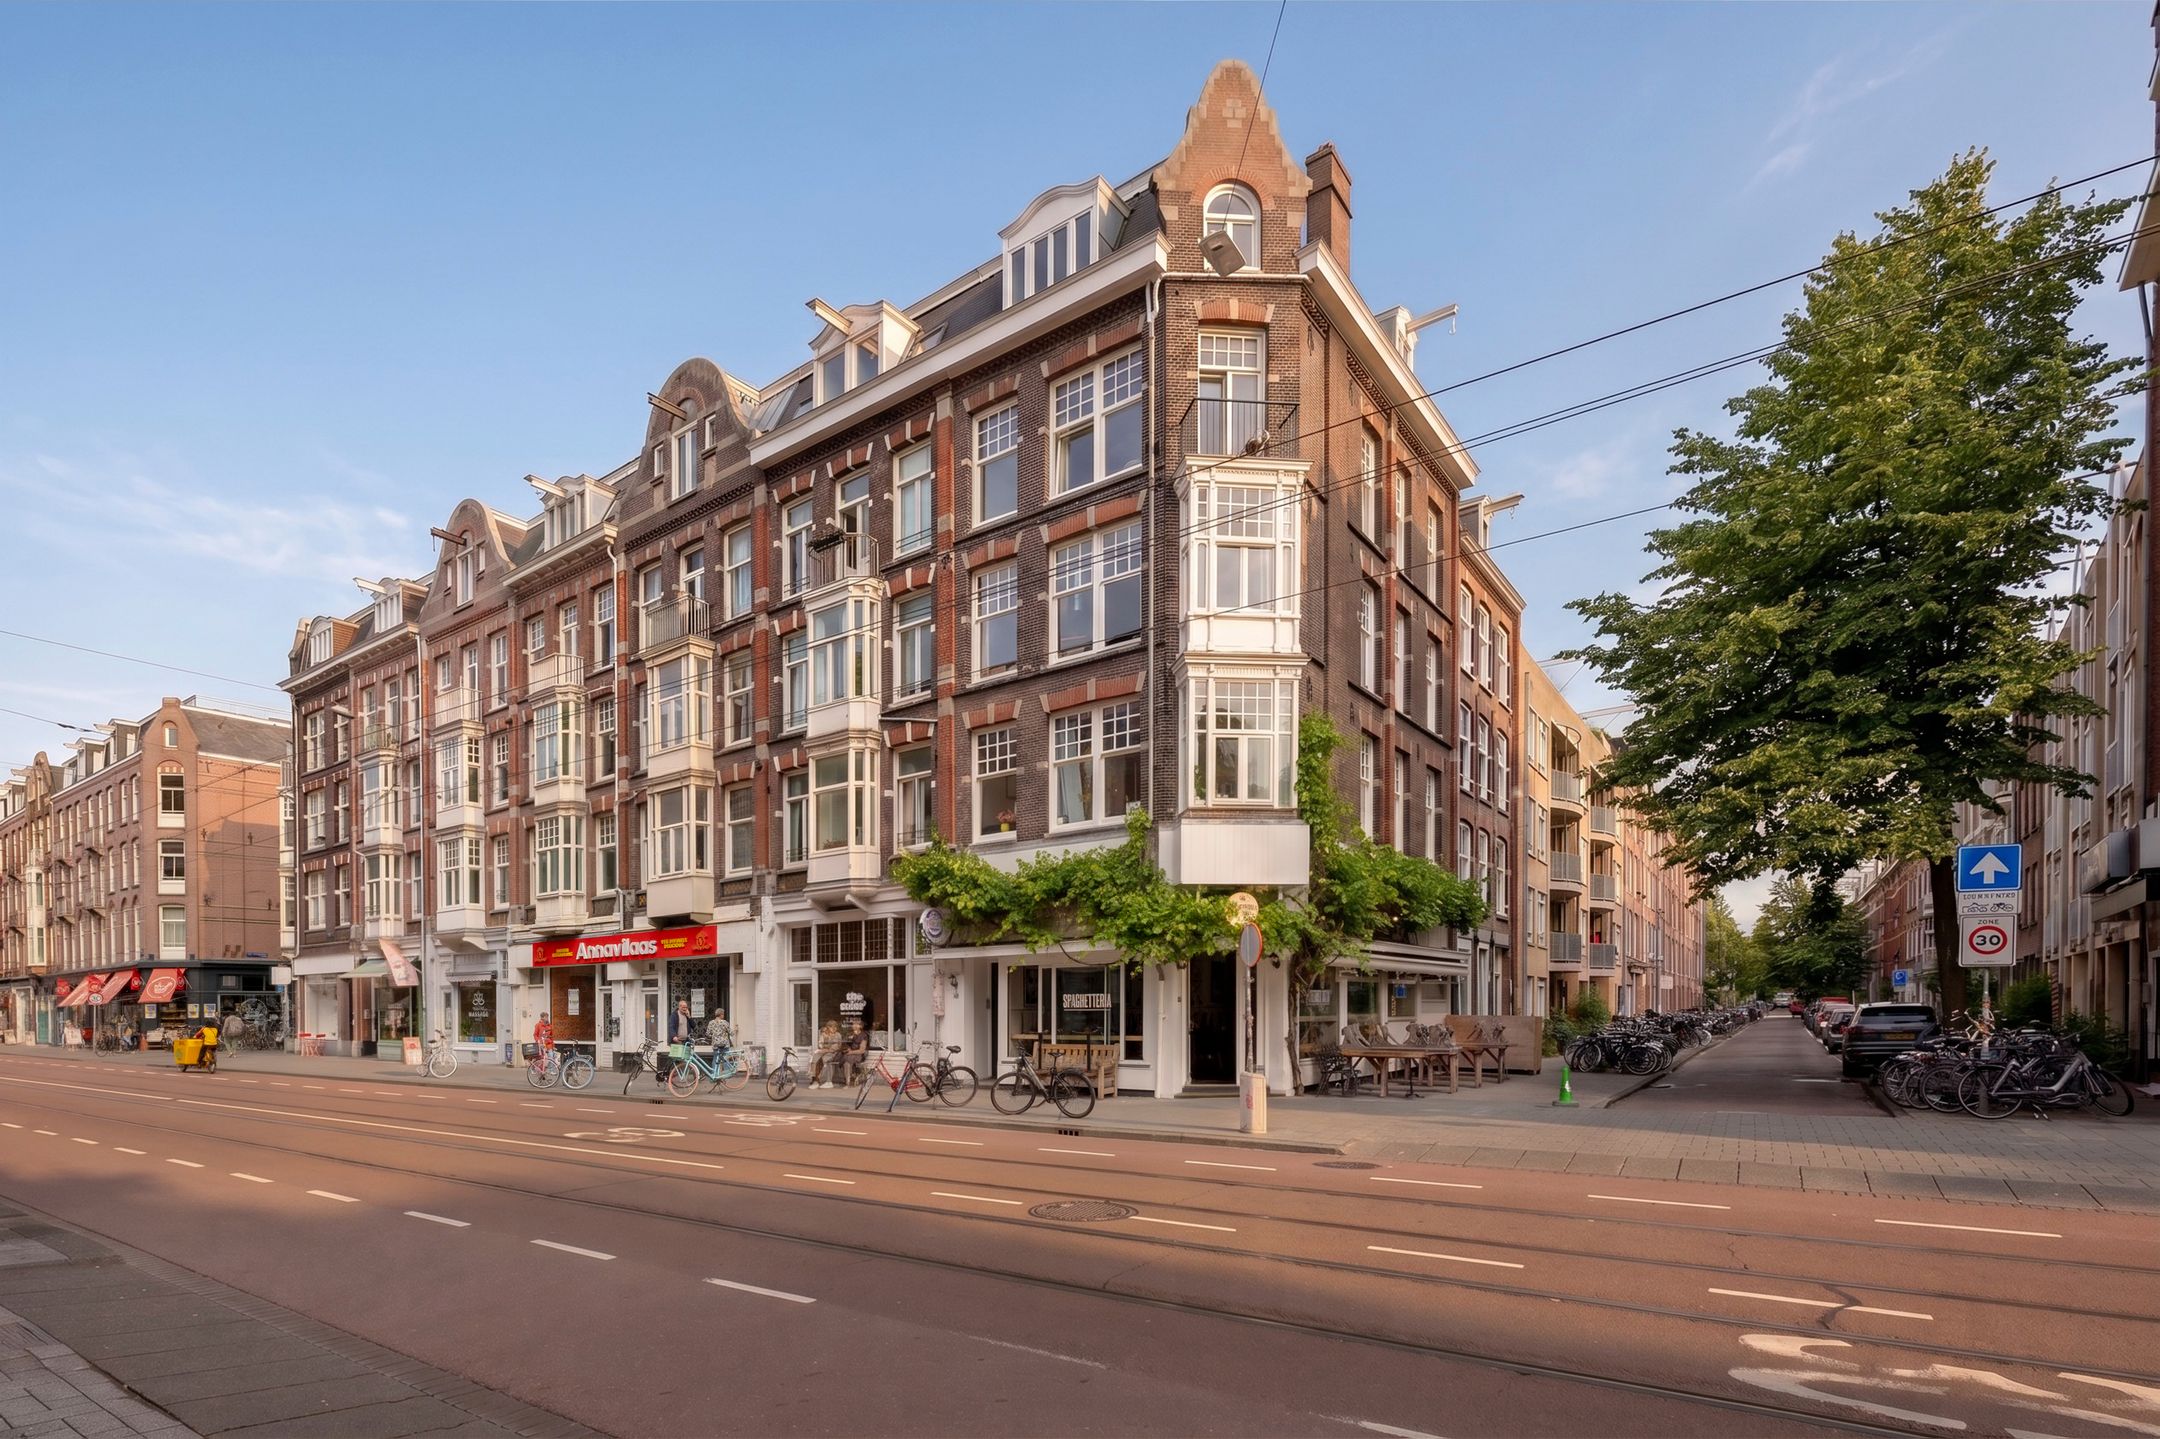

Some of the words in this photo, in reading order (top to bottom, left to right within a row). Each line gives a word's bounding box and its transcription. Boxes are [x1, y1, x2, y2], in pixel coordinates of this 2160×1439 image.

[1975, 934, 2001, 946] 30
[576, 938, 657, 960] Annavilaas
[1063, 993, 1112, 1008] SPAGHETTERIA
